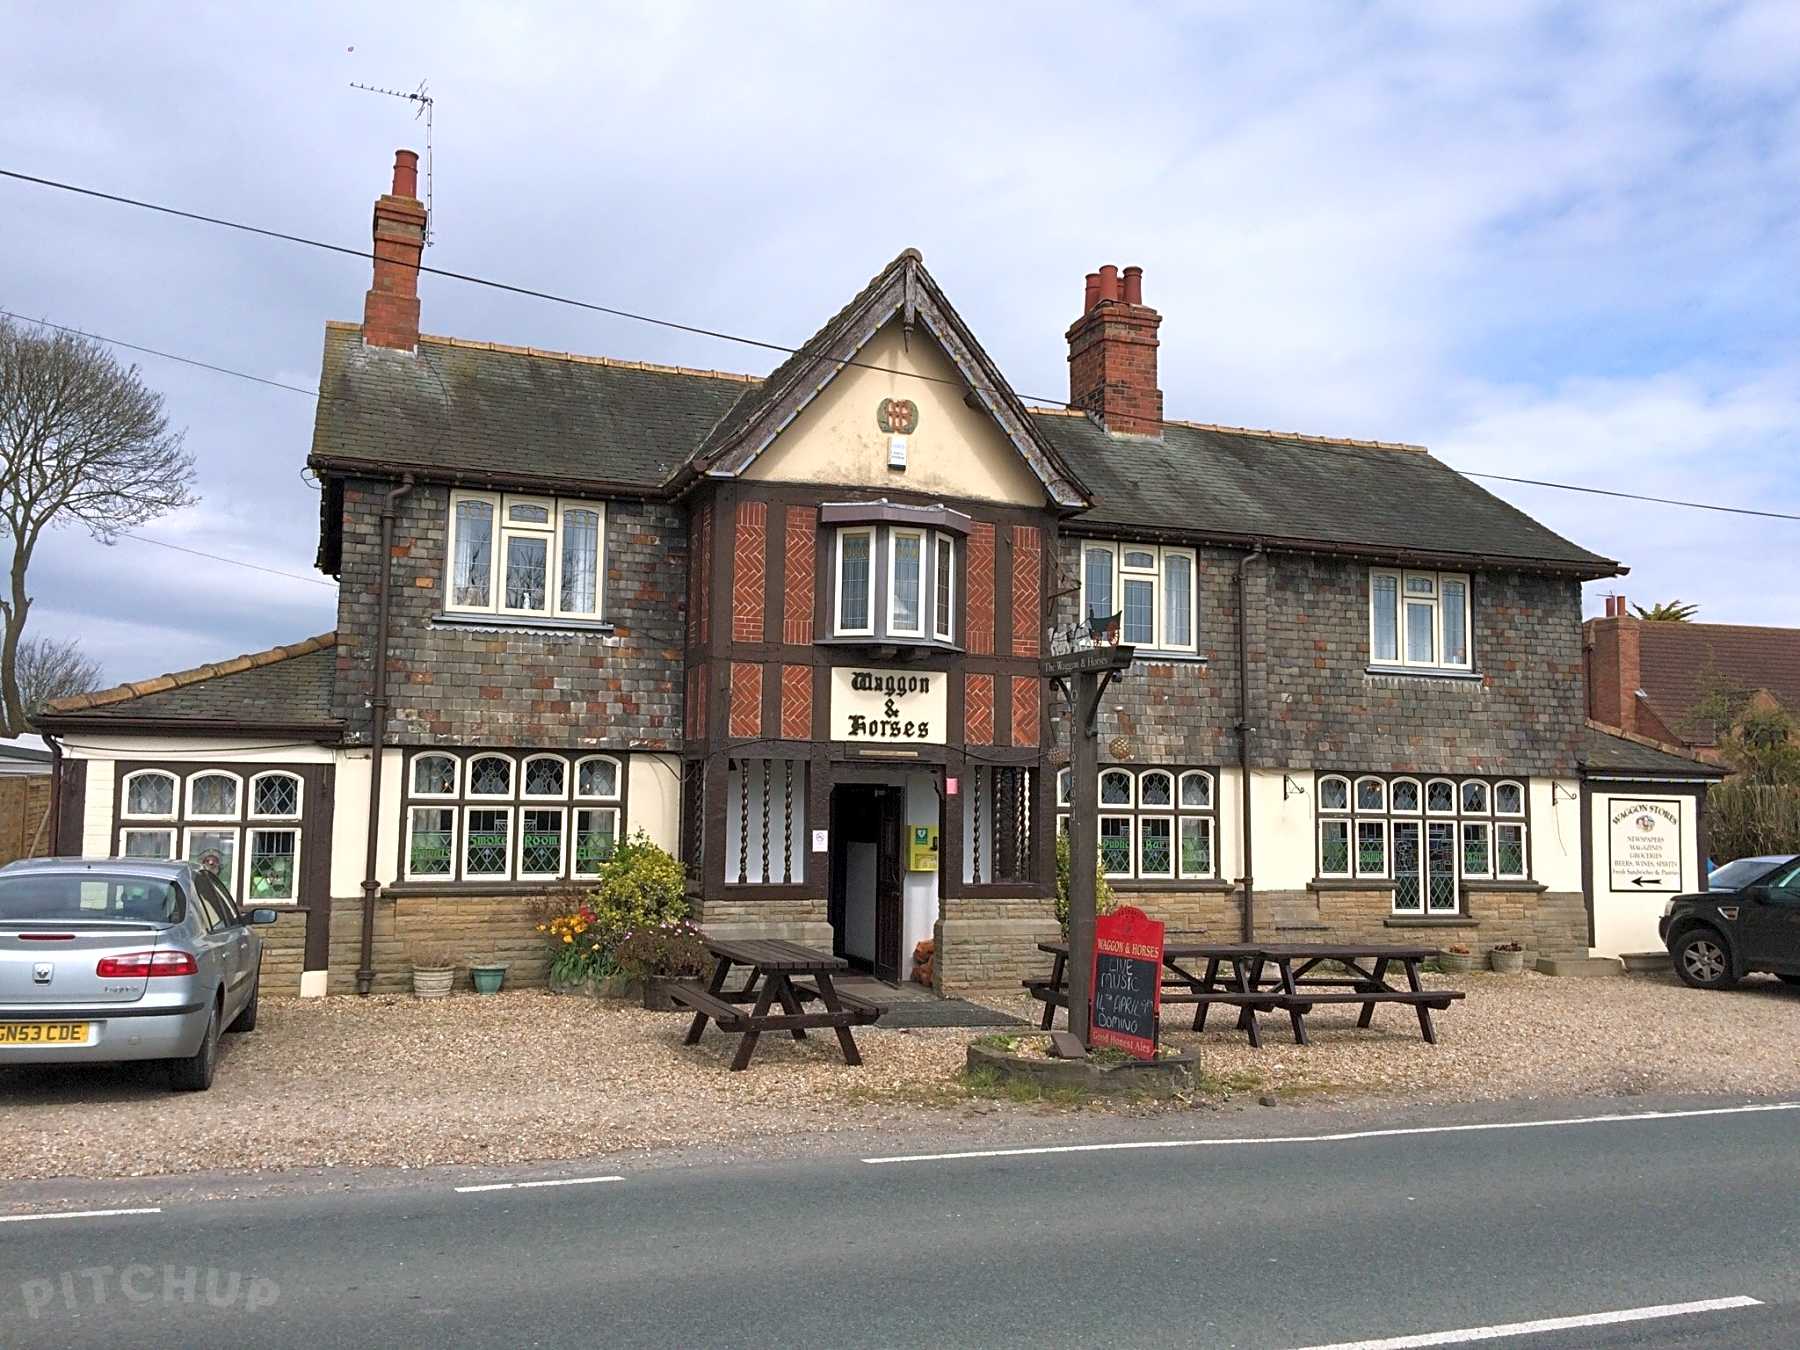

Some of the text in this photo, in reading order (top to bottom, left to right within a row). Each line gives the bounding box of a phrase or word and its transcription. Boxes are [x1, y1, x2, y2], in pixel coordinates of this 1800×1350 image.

[851, 672, 930, 697] Waggon
[884, 698, 899, 718] &
[848, 715, 929, 738] Horses
[1124, 942, 1130, 954] &
[1132, 943, 1160, 958] HORSES
[1109, 958, 1134, 976] LIVE
[1101, 972, 1140, 992] MUSIC
[46, 1025, 82, 1041] CDE
